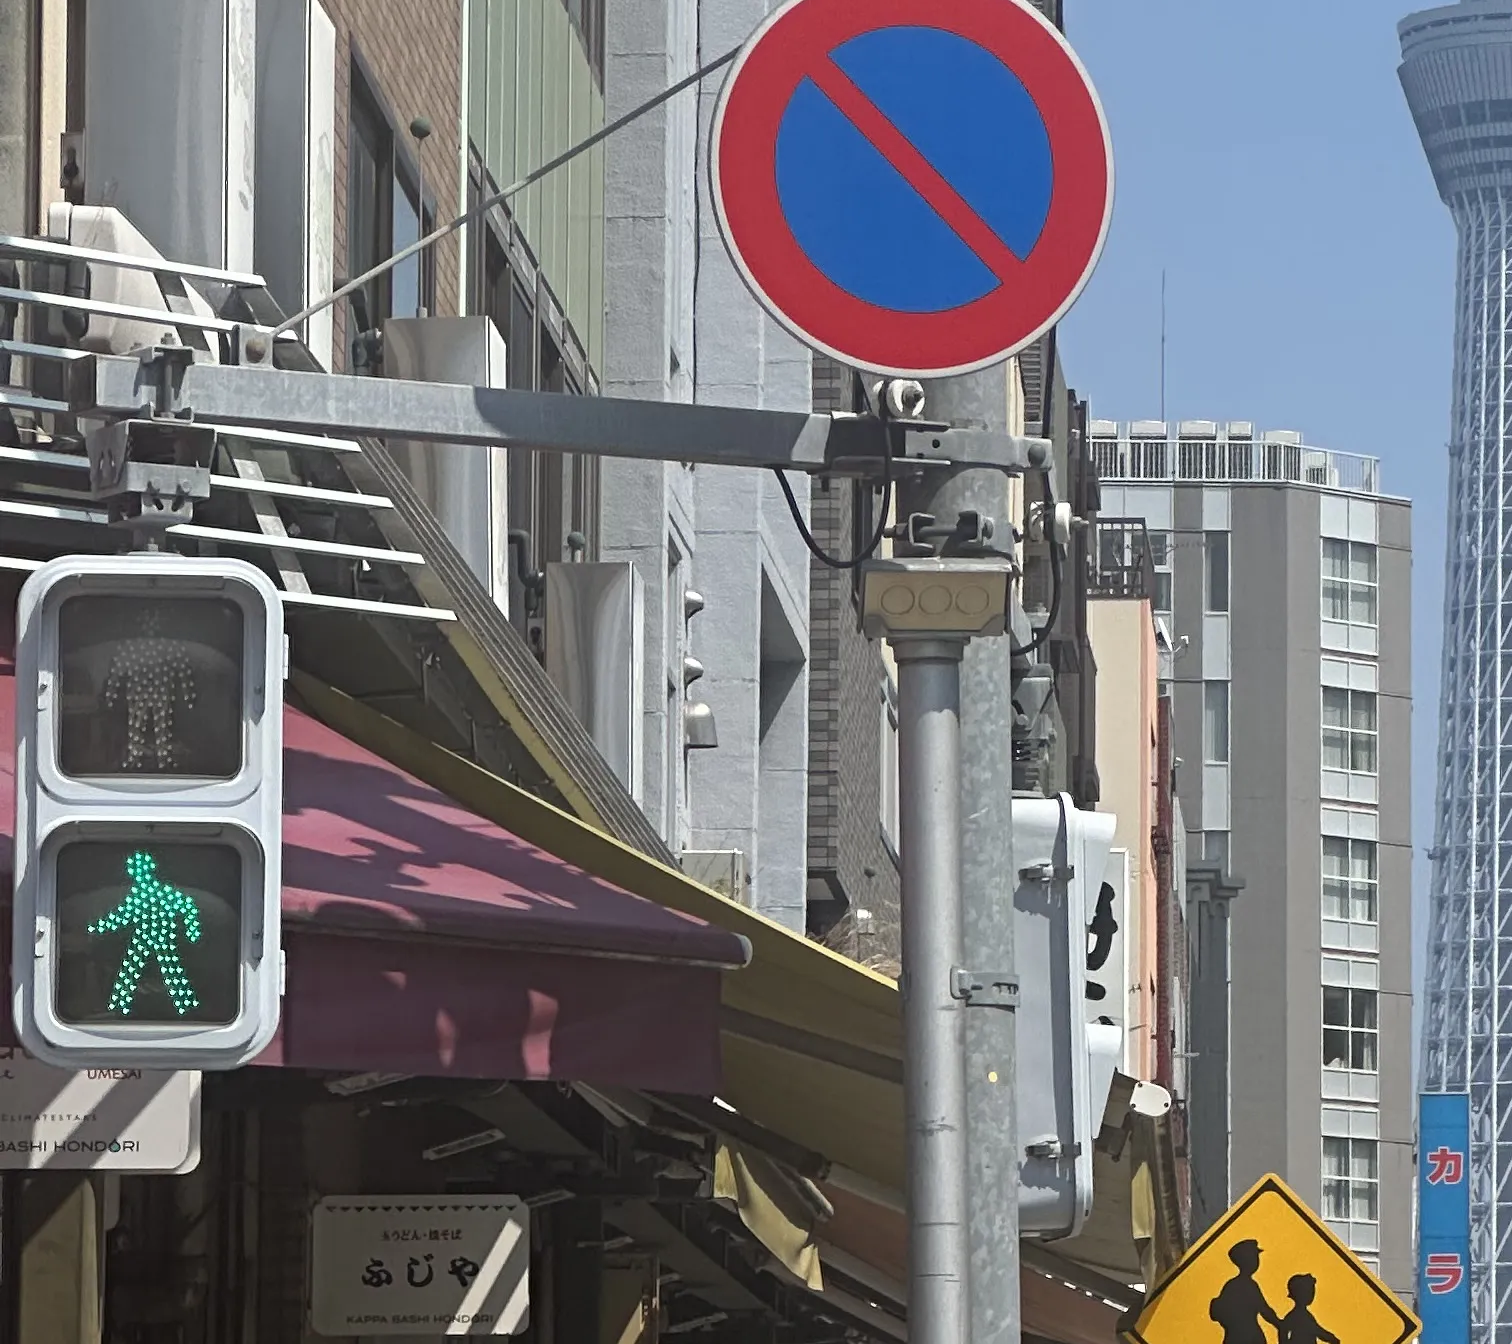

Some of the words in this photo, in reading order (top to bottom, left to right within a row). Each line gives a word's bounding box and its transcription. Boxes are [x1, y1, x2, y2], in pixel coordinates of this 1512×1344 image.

[54, 1138, 140, 1153] HONDORI
[361, 1253, 480, 1288] ふじや
